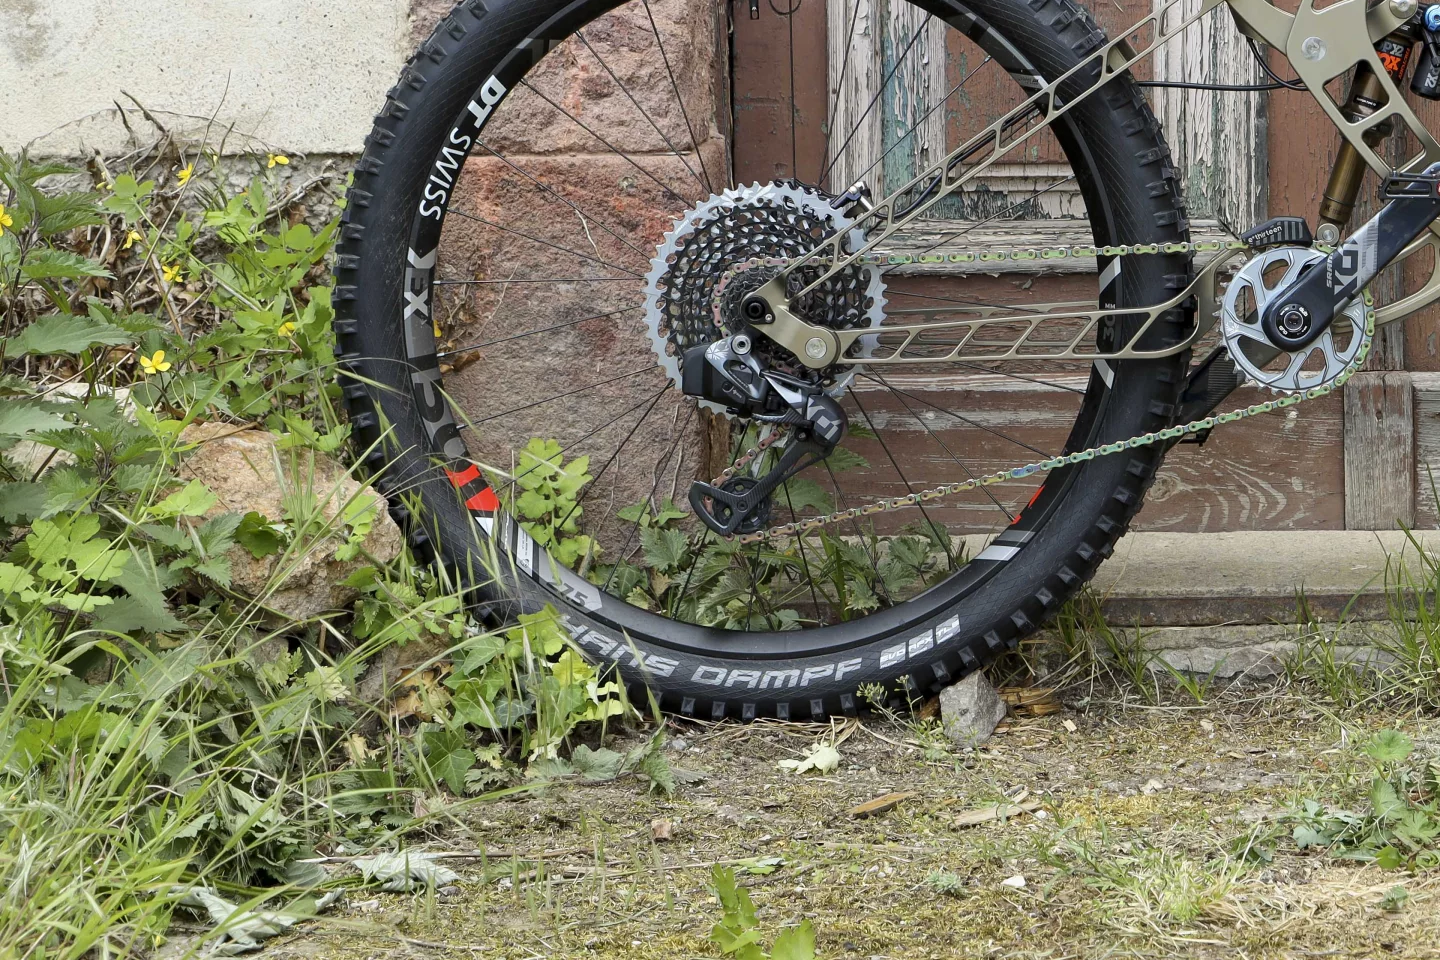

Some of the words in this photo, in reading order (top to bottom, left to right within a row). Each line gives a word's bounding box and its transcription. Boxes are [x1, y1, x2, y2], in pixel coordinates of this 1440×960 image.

[467, 74, 507, 129] DT
[419, 127, 471, 221] SWISS
[560, 615, 680, 677] HANS
[689, 657, 863, 689] DAMPF
